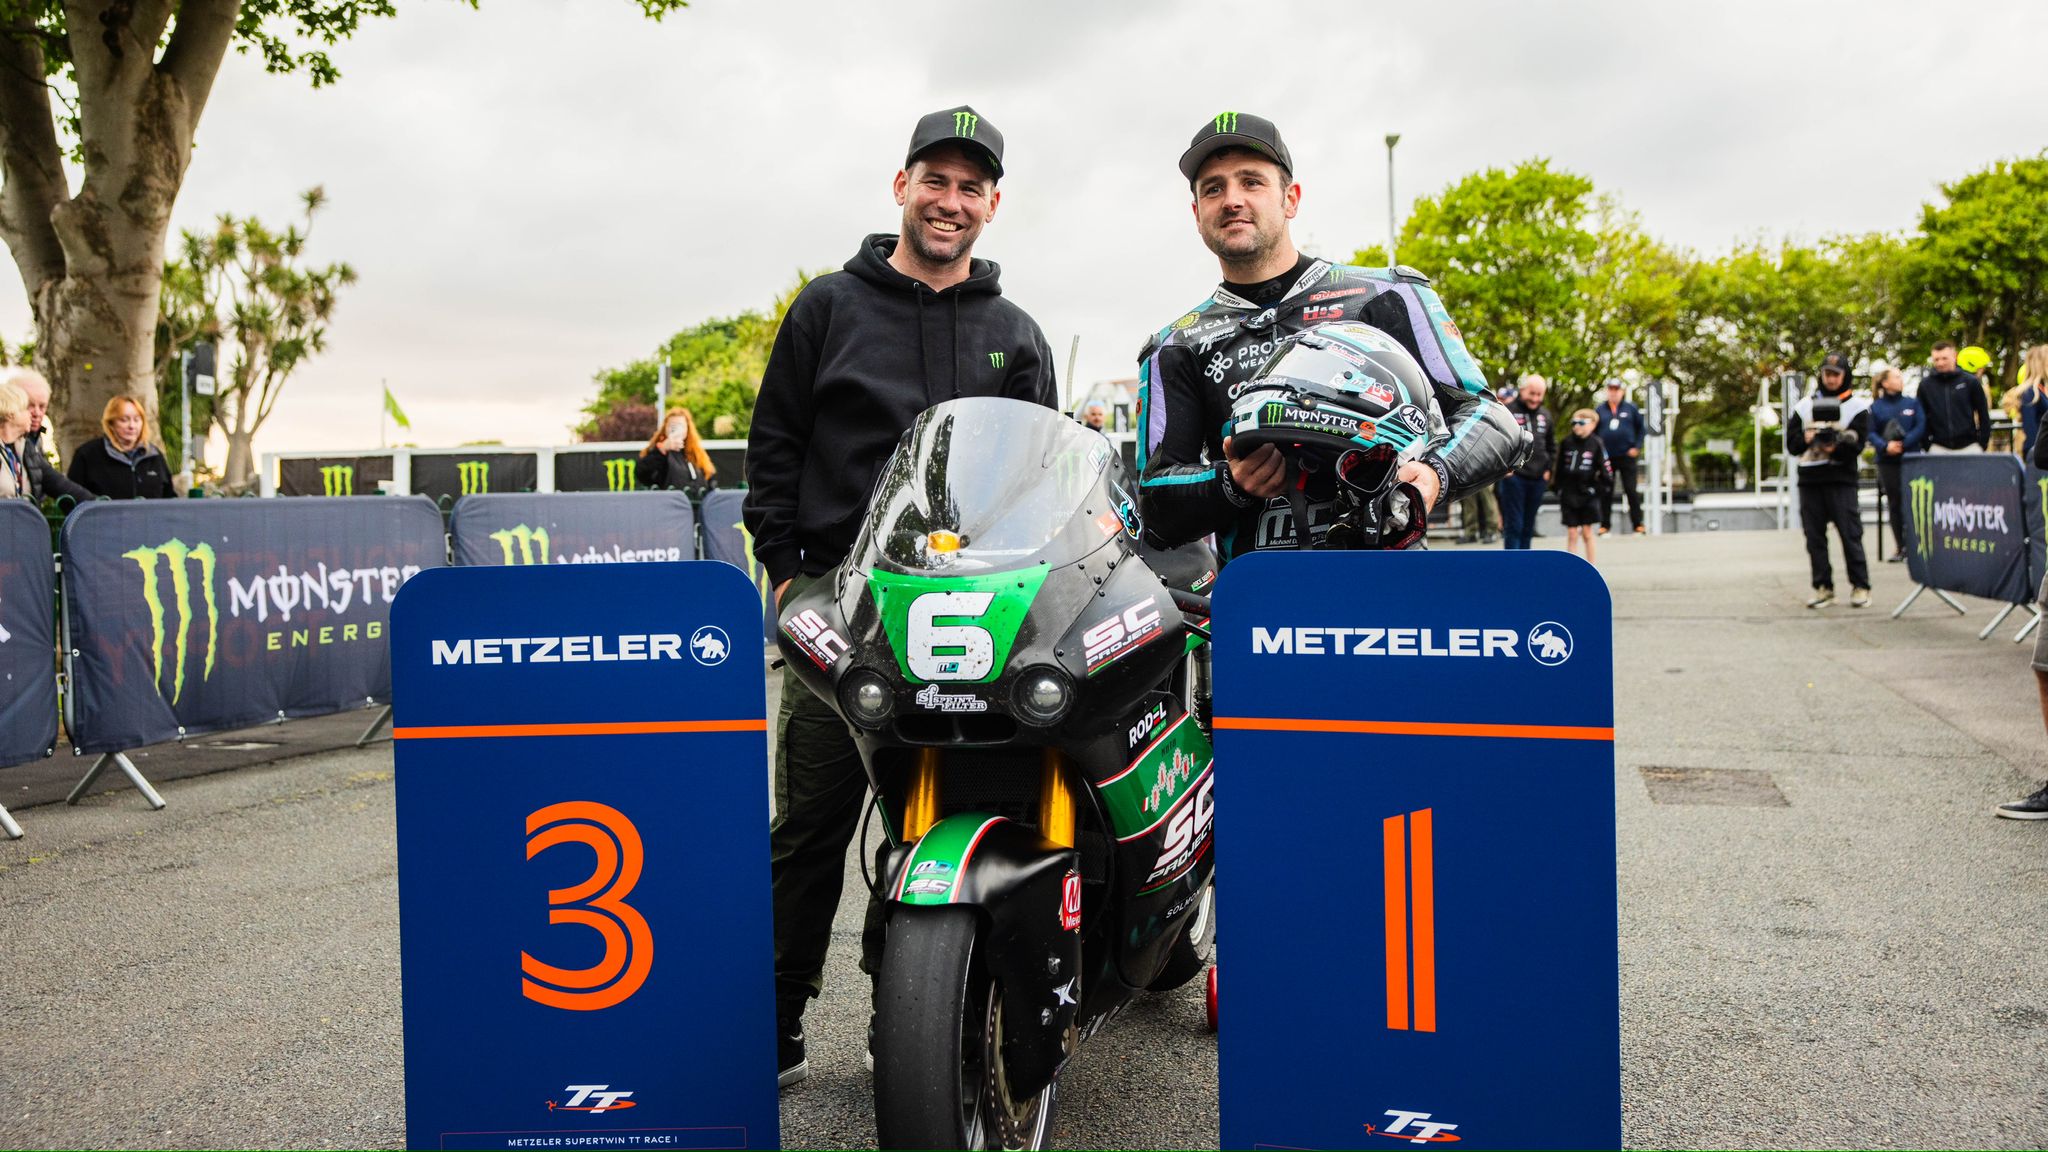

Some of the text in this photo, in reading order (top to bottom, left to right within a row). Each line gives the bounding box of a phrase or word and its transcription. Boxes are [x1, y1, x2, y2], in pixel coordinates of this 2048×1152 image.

[1239, 356, 1269, 370] WEA
[1284, 408, 1359, 432] MONSTER
[1294, 422, 1348, 437] ENERGY
[1934, 497, 2009, 534] MONSTER
[1944, 536, 1996, 554] ENERGY
[267, 621, 382, 651] ENERG
[785, 620, 834, 665] PROJECT
[791, 609, 849, 662] SC
[907, 592, 996, 681] 6
[1083, 597, 1160, 659] SC
[1087, 618, 1161, 667] PROJECT
[1252, 627, 1519, 657] METZELER
[432, 633, 682, 665] METZELER
[944, 701, 986, 711] FILTER
[521, 800, 654, 1011] 3
[1383, 807, 1436, 1033] 1
[508, 1138, 562, 1147] METZELER
[565, 1136, 625, 1146] SUPERTWIN
[628, 1136, 641, 1145] TT
[644, 1135, 671, 1144] RACE
